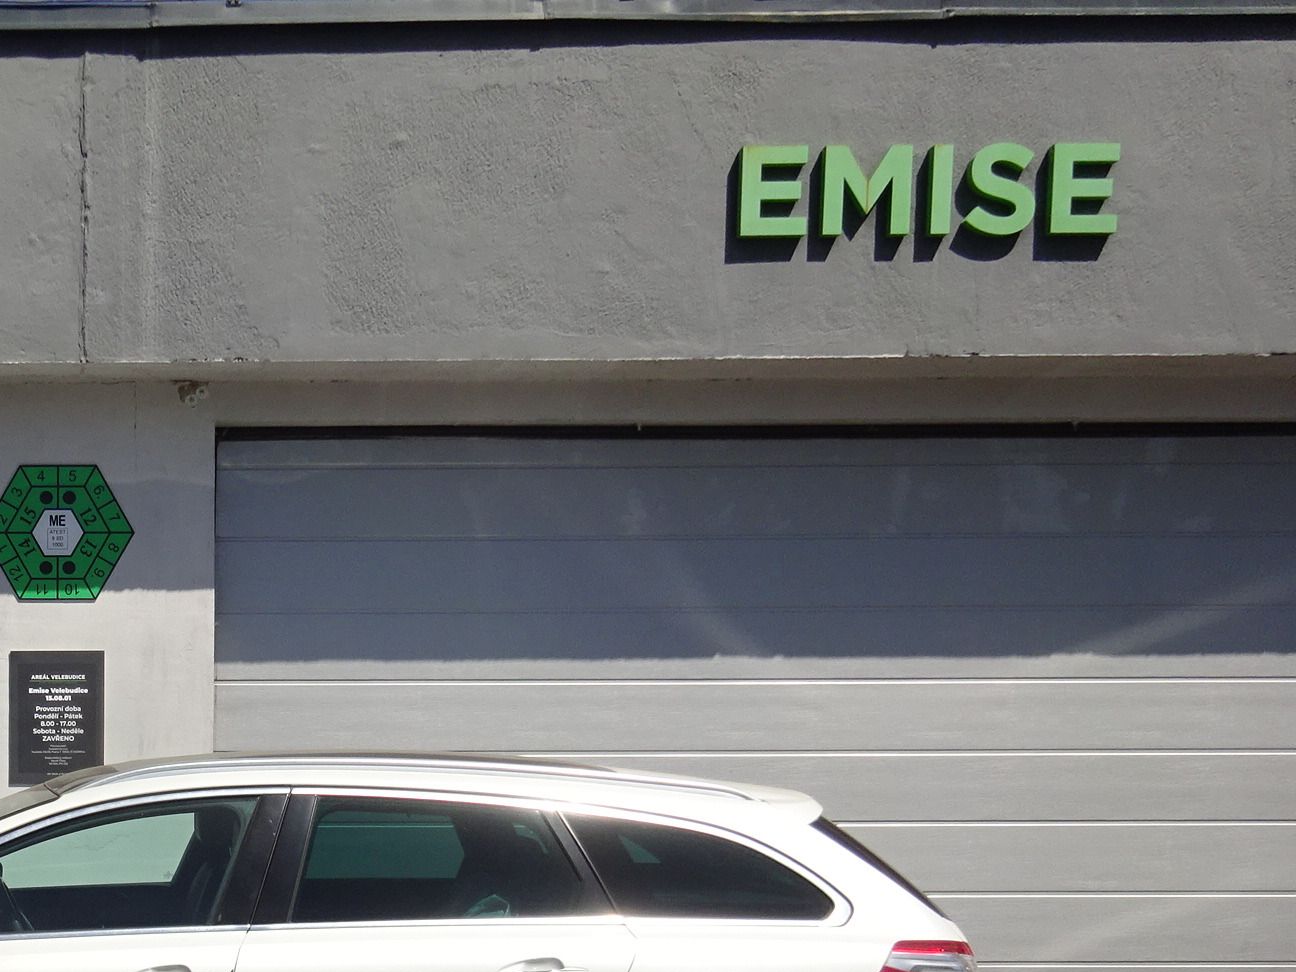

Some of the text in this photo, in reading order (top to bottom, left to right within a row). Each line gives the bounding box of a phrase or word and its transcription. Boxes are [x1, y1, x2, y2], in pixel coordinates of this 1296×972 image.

[735, 141, 1122, 238] EMISE
[37, 470, 45, 482] 4
[68, 470, 77, 482] 5
[11, 487, 23, 497] 3
[19, 506, 37, 526] 15
[49, 514, 66, 527] ME
[79, 507, 97, 526] 12
[109, 513, 121, 521] 7
[18, 537, 36, 556] 14
[80, 539, 97, 557] 13
[108, 542, 120, 553] 8
[8, 565, 24, 582] 12
[36, 583, 49, 596] 11
[64, 583, 80, 596] 10
[50, 686, 89, 694] Velebudice
[61, 727, 85, 735] Neděle
[42, 734, 75, 742] ZAVŘENO
